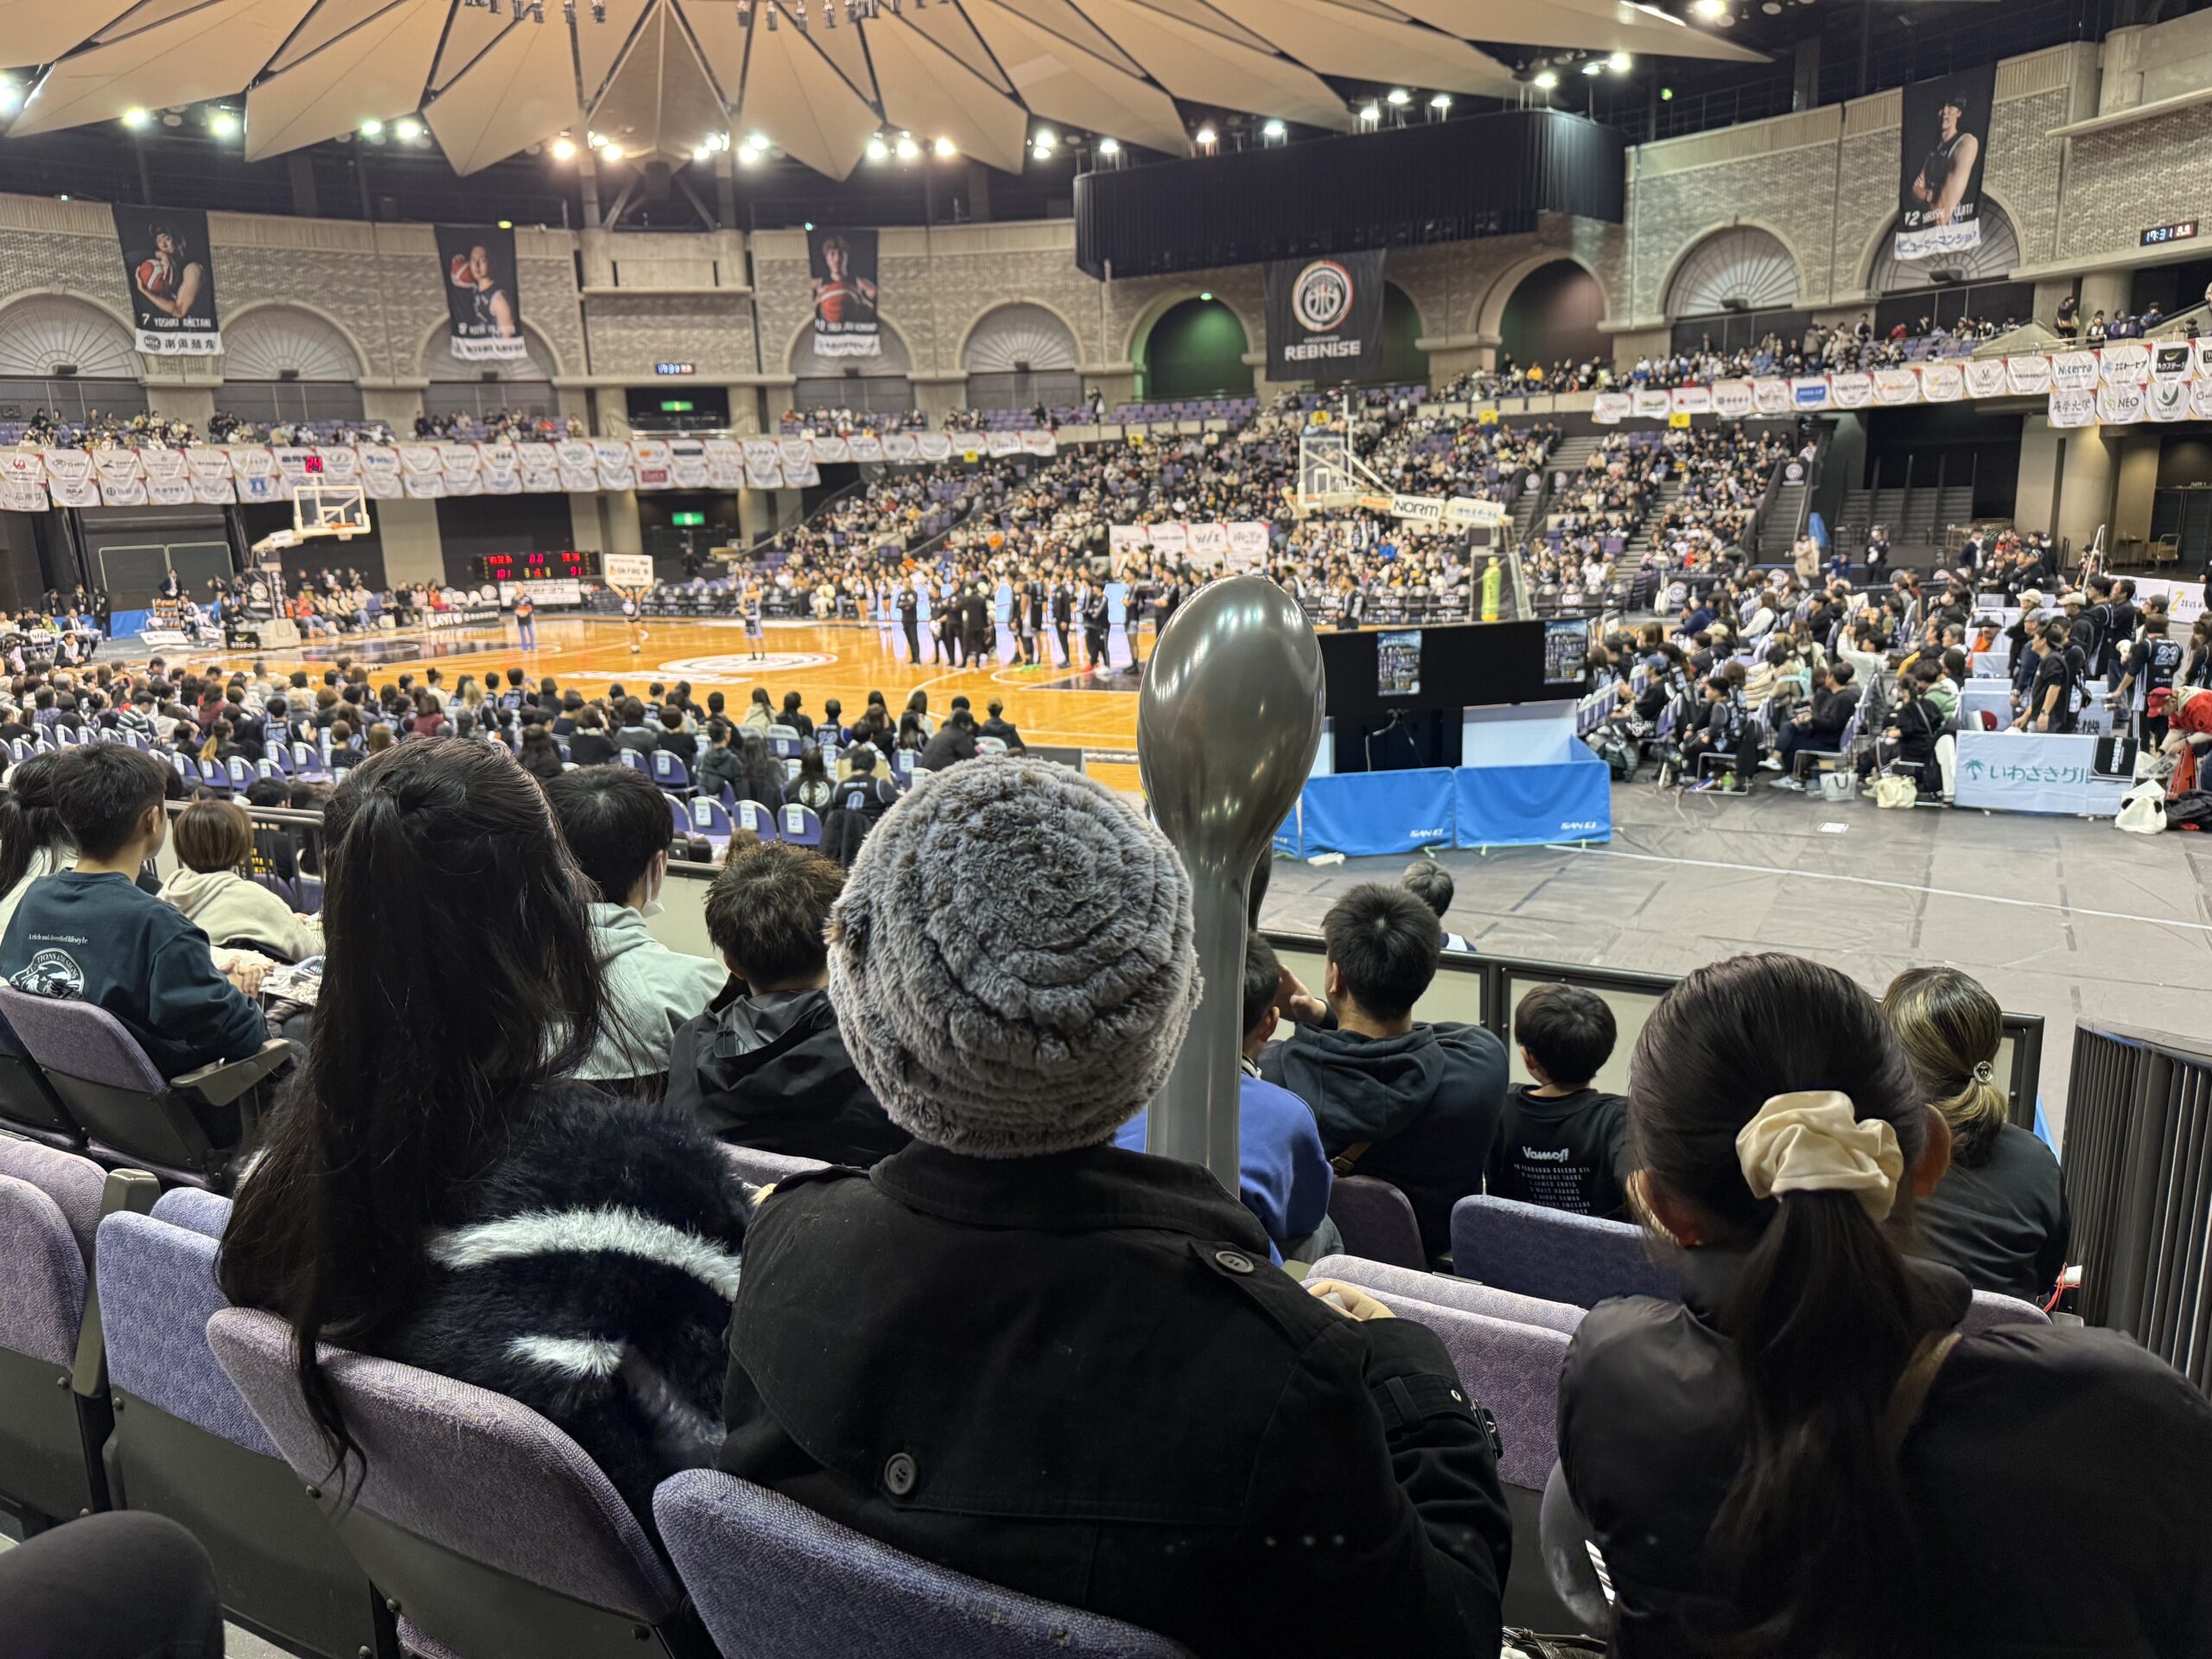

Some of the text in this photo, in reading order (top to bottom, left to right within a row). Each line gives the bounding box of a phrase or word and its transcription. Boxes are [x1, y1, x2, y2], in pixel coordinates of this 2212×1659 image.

[1904, 210, 1920, 226] 12
[2146, 228, 2173, 243] 17:31
[142, 313, 150, 326] 7
[1284, 340, 1361, 361] REBNISE
[2058, 364, 2092, 376] Niterra
[2118, 397, 2139, 408] NEO
[1989, 766, 2097, 785] いわさきグル
